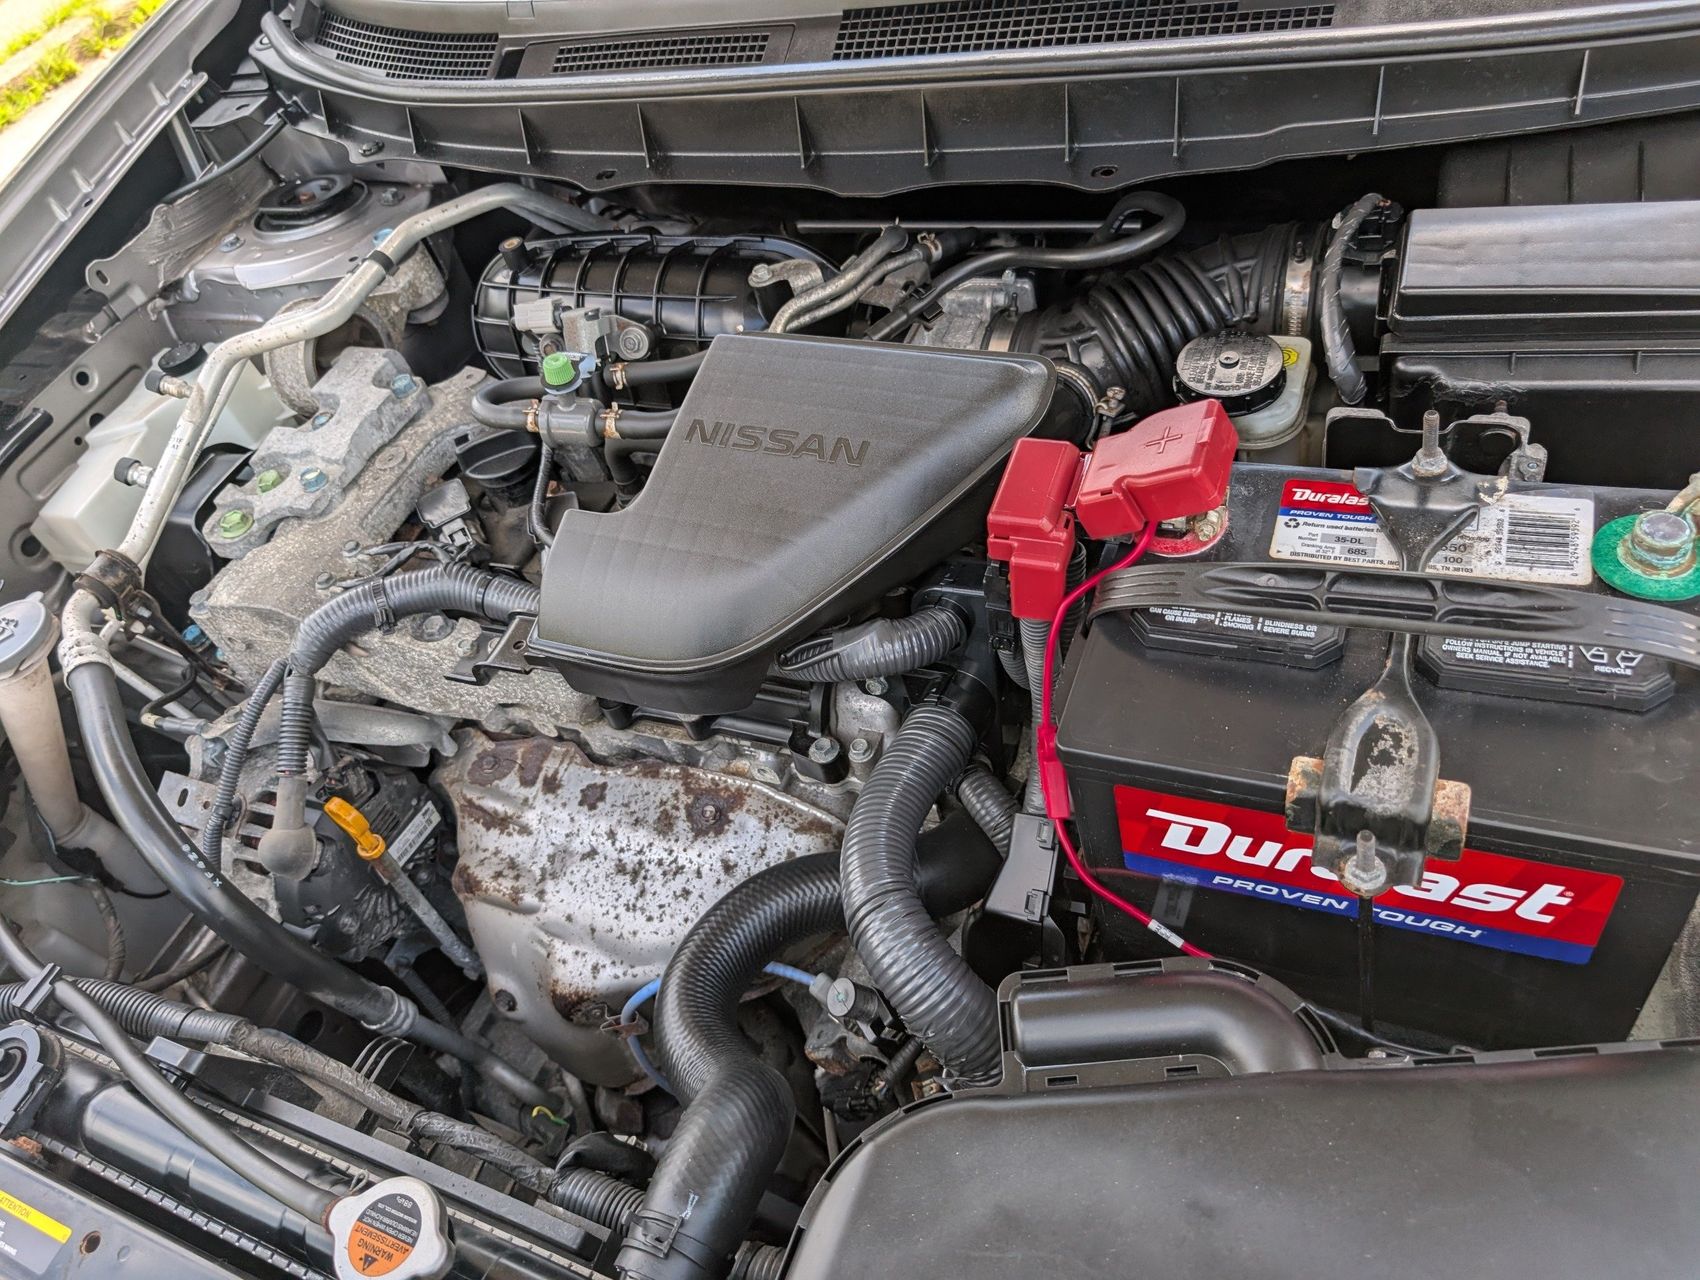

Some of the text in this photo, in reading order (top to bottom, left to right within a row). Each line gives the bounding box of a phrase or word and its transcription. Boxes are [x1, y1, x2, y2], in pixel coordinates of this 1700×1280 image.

[684, 418, 871, 467] NISSAN
[1291, 488, 1370, 506] Duralas
[1290, 509, 1373, 521] PROVEN TOUGH
[1302, 521, 1325, 529] Return
[1344, 525, 1375, 533] batteries
[1334, 536, 1364, 545] 35-DL
[1289, 551, 1332, 560] DISTRIBUTED
[1347, 547, 1367, 556] 685
[1223, 615, 1252, 624] FLAMES
[1264, 619, 1318, 632] BLINDNESS OR
[1222, 621, 1254, 631] SMOKING
[1263, 626, 1316, 638] SEVERE BURNS
[1445, 638, 1473, 647] FOLLOW
[1474, 642, 1524, 653] INSTRUCTIONS
[1535, 648, 1564, 657] VEHICLE
[1531, 642, 1567, 651] STARTING
[1442, 643, 1471, 653] OWNERS
[1512, 652, 1528, 660] NOT
[1529, 654, 1567, 664] AVAILABLE
[1455, 651, 1474, 660] SEEK
[1475, 654, 1504, 663] SERVICE
[1593, 665, 1632, 675] RECYCLE
[1146, 808, 1573, 924] Durast
[1212, 875, 1483, 939] PROVEN OUGH
[355, 1225, 409, 1255] AVERTISSEMENT
[357, 1238, 394, 1262] WARNING
